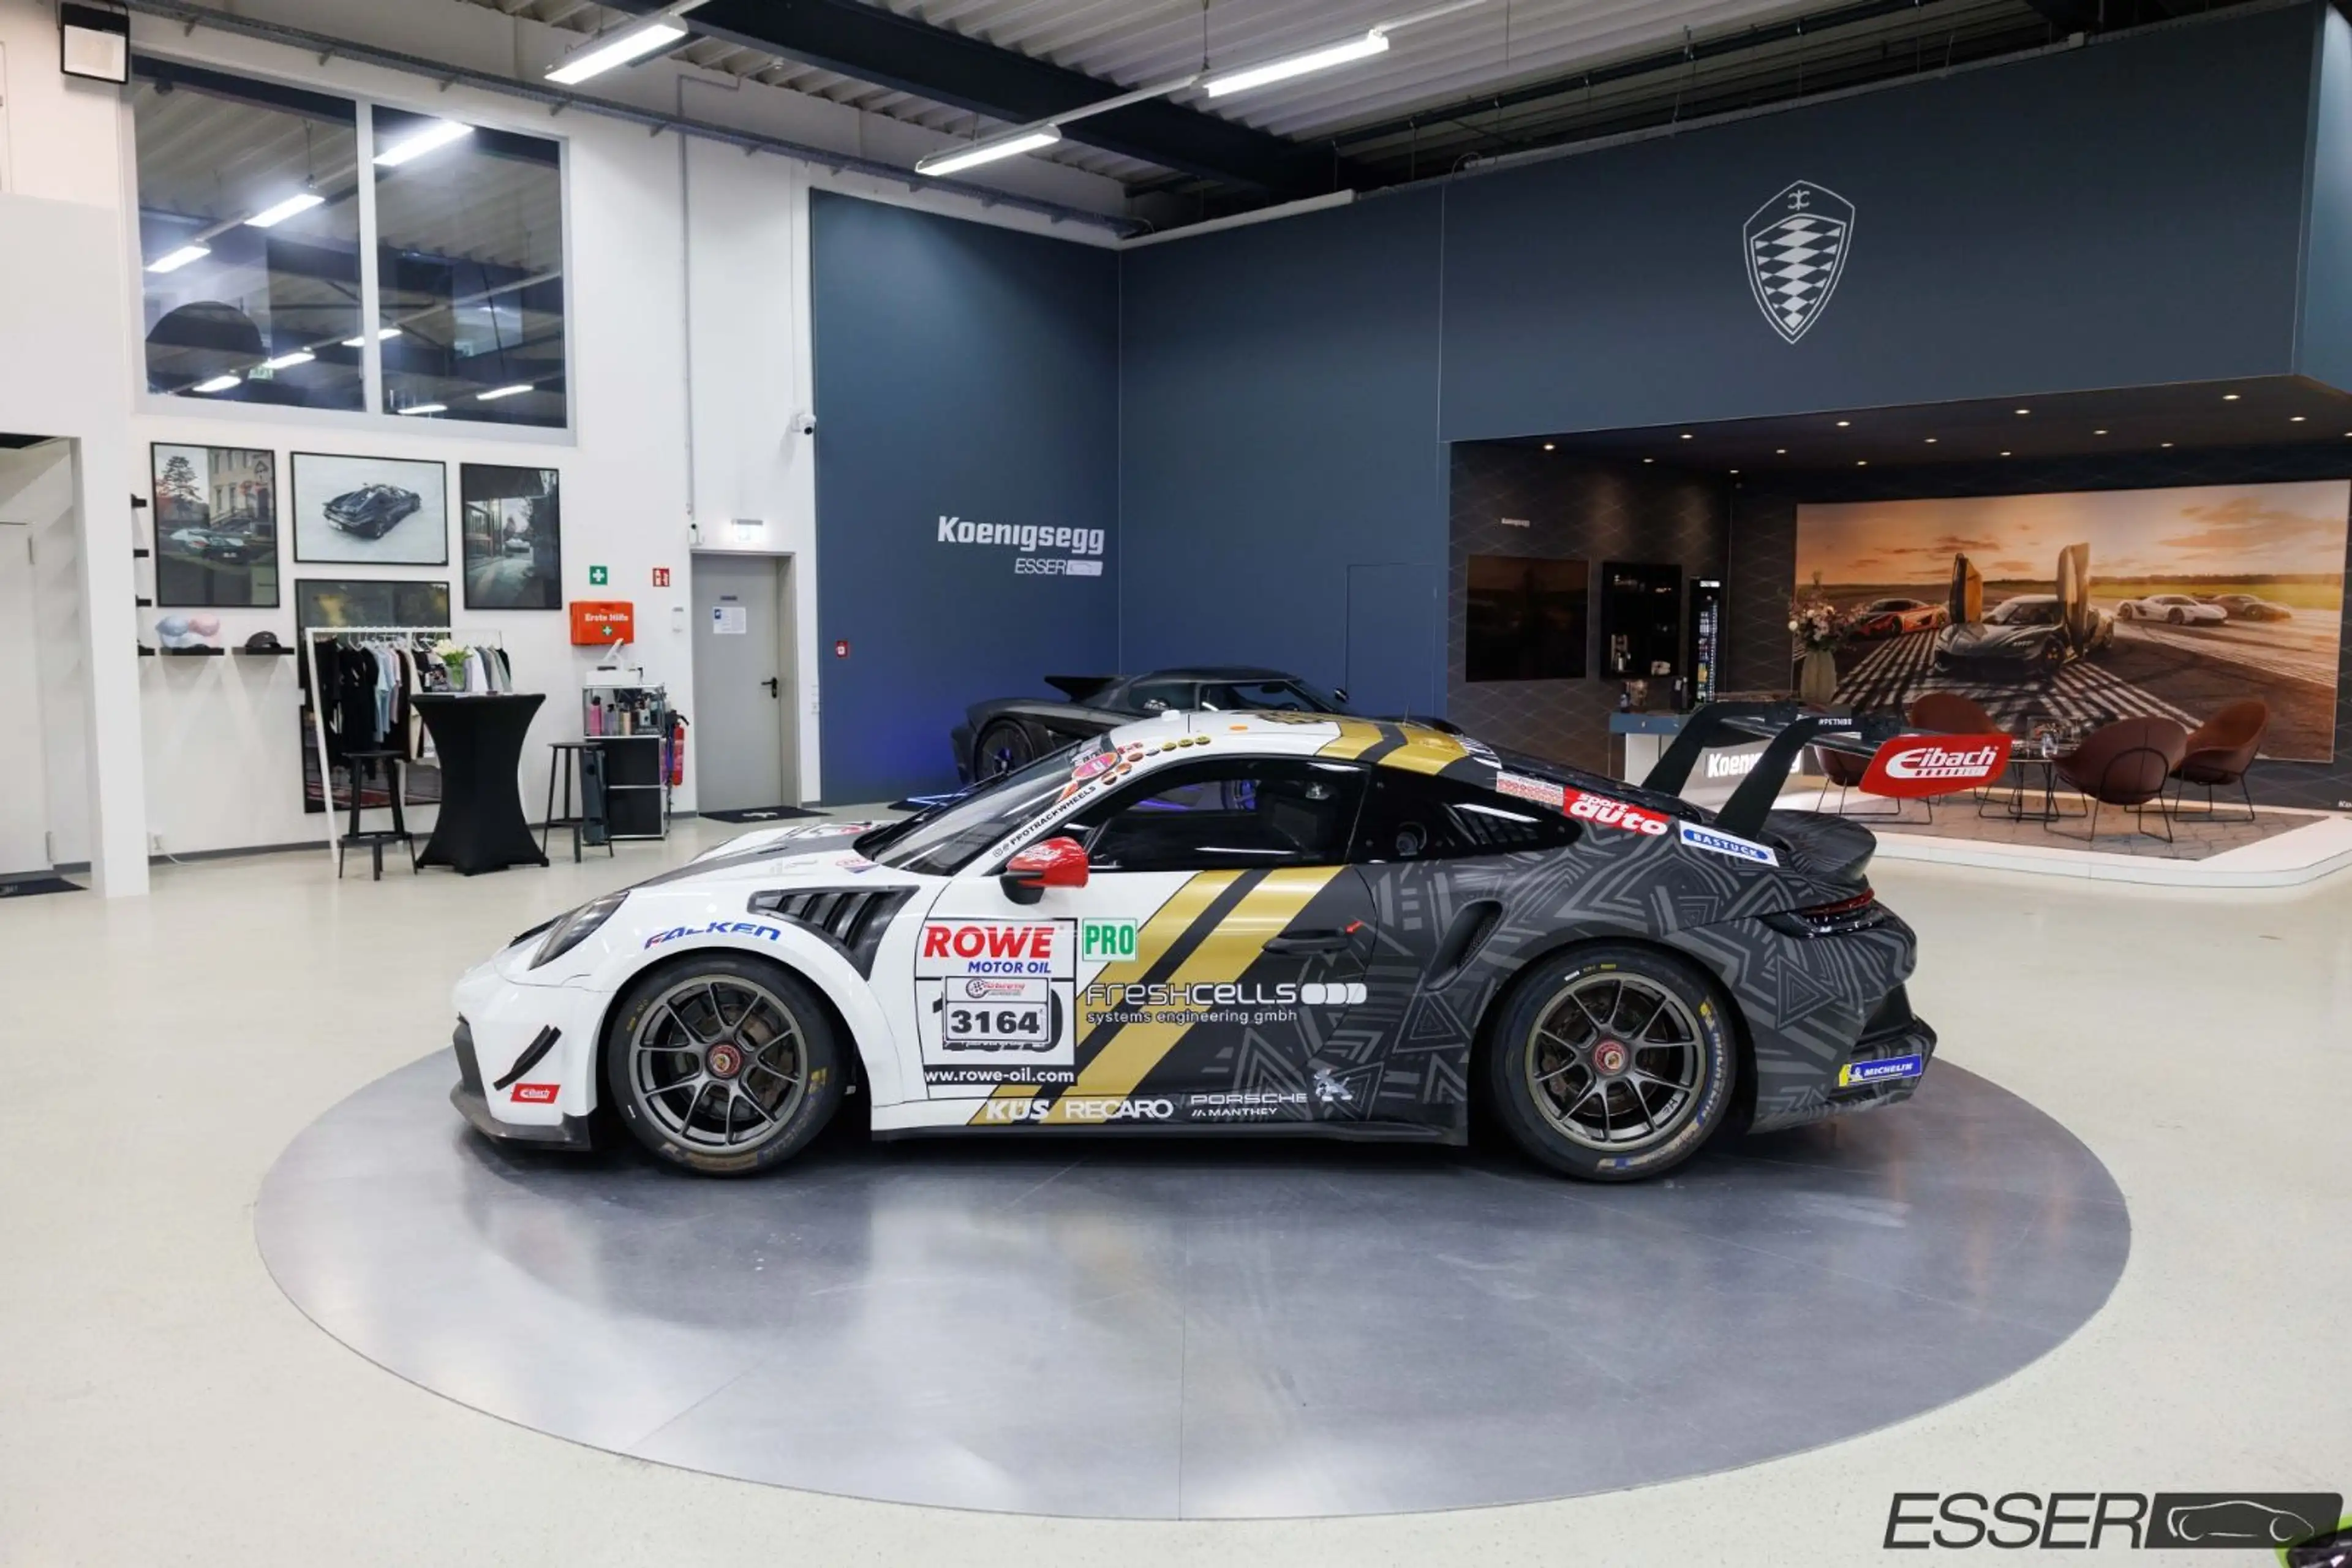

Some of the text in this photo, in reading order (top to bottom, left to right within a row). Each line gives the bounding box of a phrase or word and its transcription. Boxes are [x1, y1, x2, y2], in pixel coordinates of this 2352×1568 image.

[937, 515, 1105, 555] Koenigsegg
[1014, 558, 1067, 575] ESSER
[1885, 745, 1998, 779] Eibach
[1577, 793, 1630, 813] sport
[1569, 801, 1668, 836] auto
[1693, 831, 1758, 858] BASTUCK
[644, 921, 782, 950] FALKEN
[922, 925, 1054, 959] ROWE
[1085, 924, 1134, 955] PRO
[968, 960, 1052, 973] MOTOR OIL
[950, 1009, 1040, 1034] 3164
[1087, 1009, 1297, 1026] systems engineering gmbh
[1864, 1063, 1913, 1077] MICHELIN
[1065, 1099, 1174, 1119] RECARO
[1190, 1093, 1308, 1104] PORSCHE
[986, 1099, 1049, 1120] KÜS
[1208, 1107, 1278, 1117] MANTHEY
